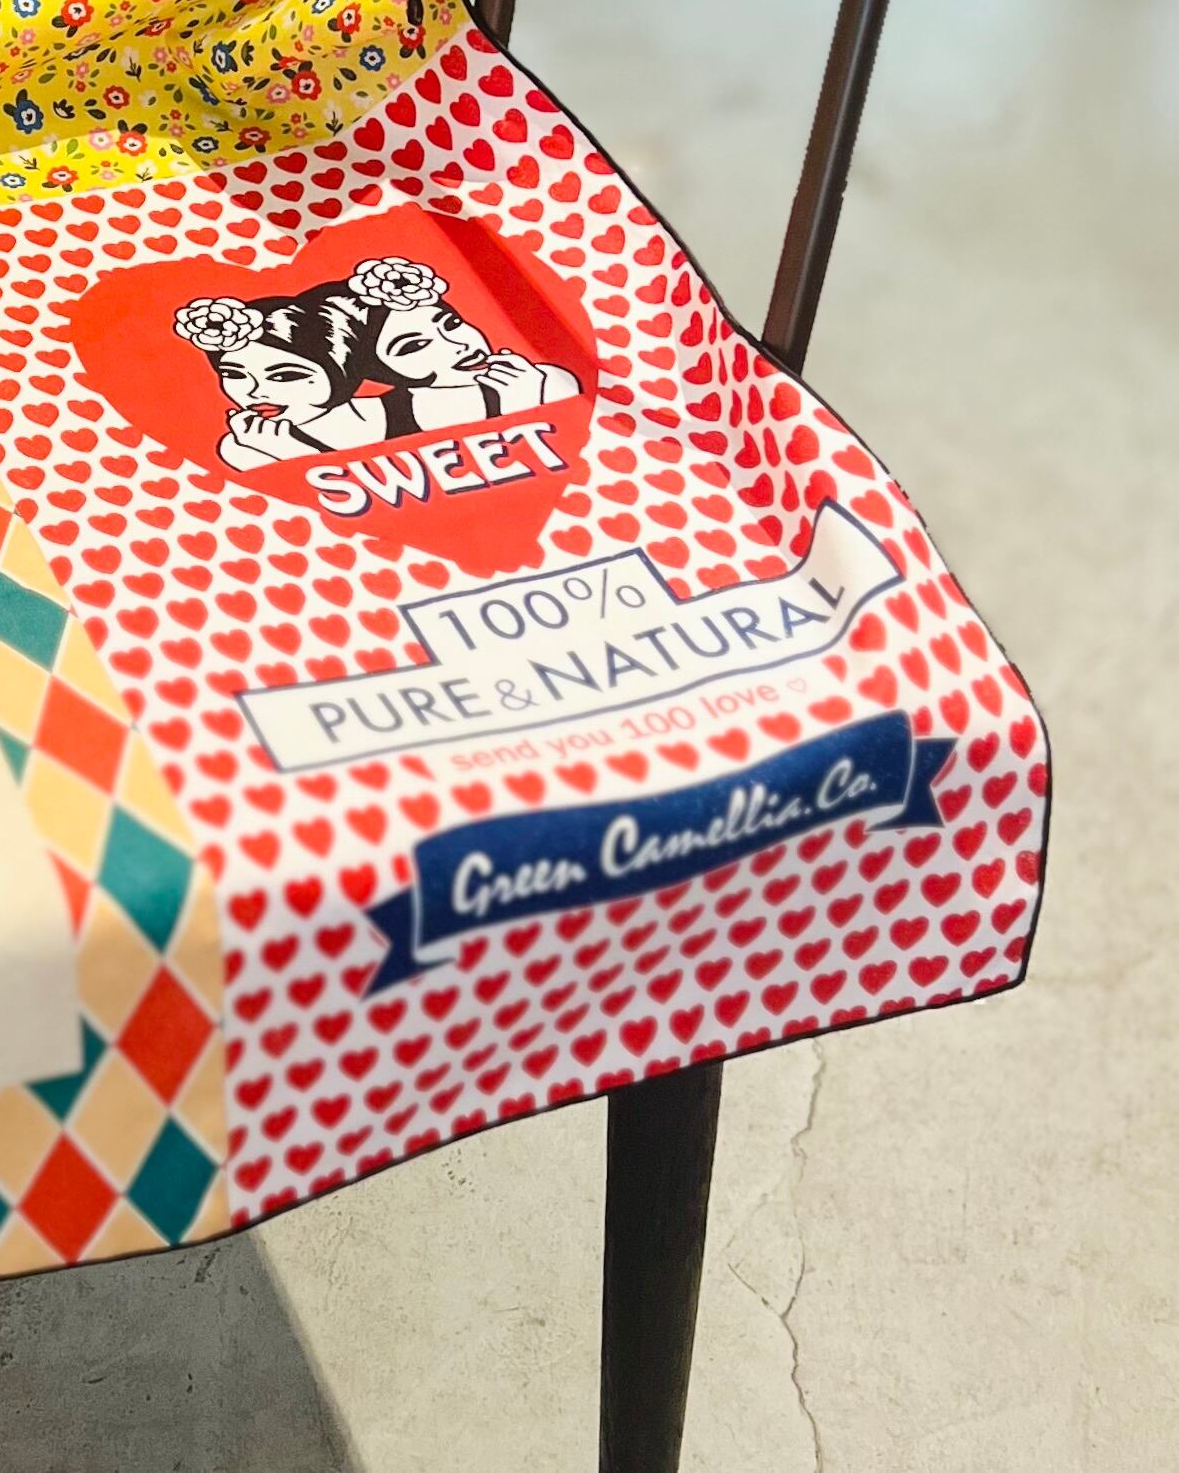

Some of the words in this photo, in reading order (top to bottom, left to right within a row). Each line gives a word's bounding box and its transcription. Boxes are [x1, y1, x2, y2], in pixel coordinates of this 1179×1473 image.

[305, 422, 567, 518] SWEET
[438, 568, 647, 652] 100%
[450, 742, 538, 774] send
[547, 728, 614, 760] you
[621, 706, 696, 742] 100
[702, 682, 779, 721] love
[451, 851, 588, 917] Green
